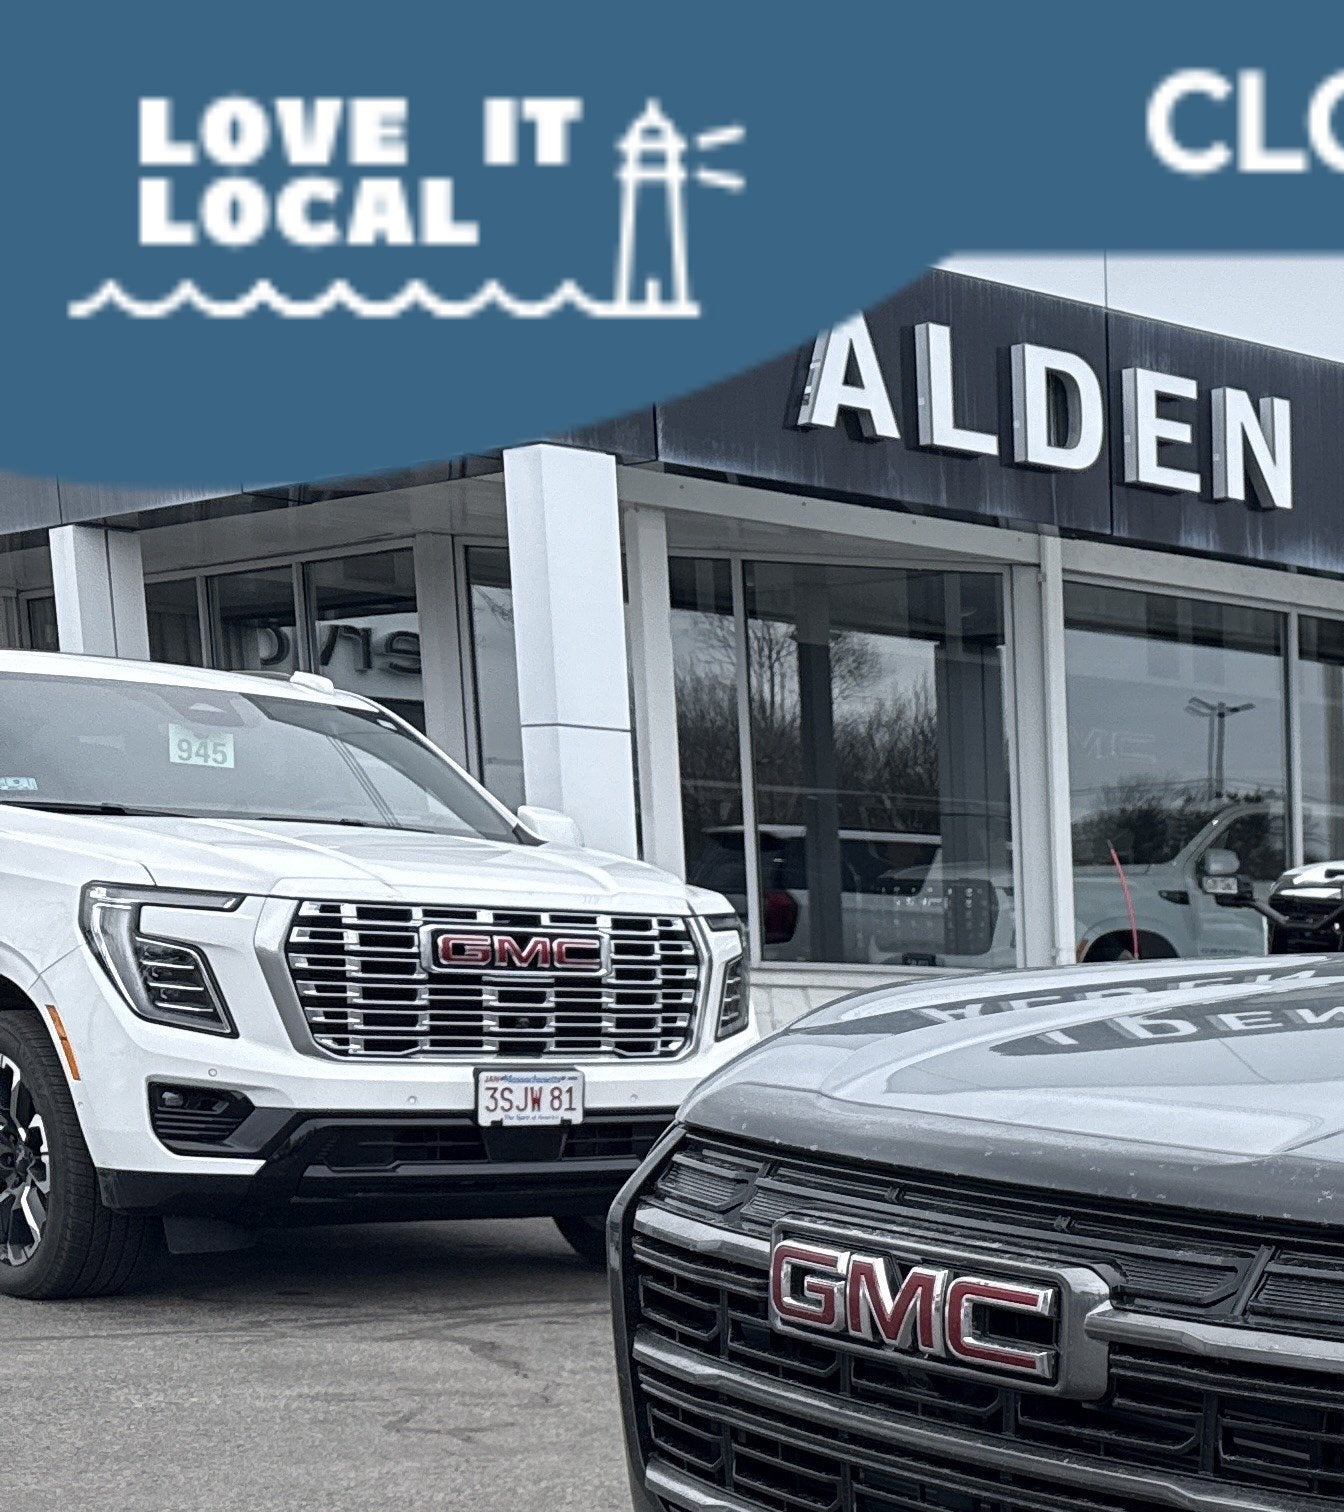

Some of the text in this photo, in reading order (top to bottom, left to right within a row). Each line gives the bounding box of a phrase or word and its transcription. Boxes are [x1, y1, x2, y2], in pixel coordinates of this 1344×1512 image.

[797, 311, 1293, 510] ALDEN
[177, 738, 227, 765] 945
[437, 934, 601, 969] GMC
[485, 1086, 576, 1112] 3SJW 81
[769, 1239, 1054, 1380] GMC
